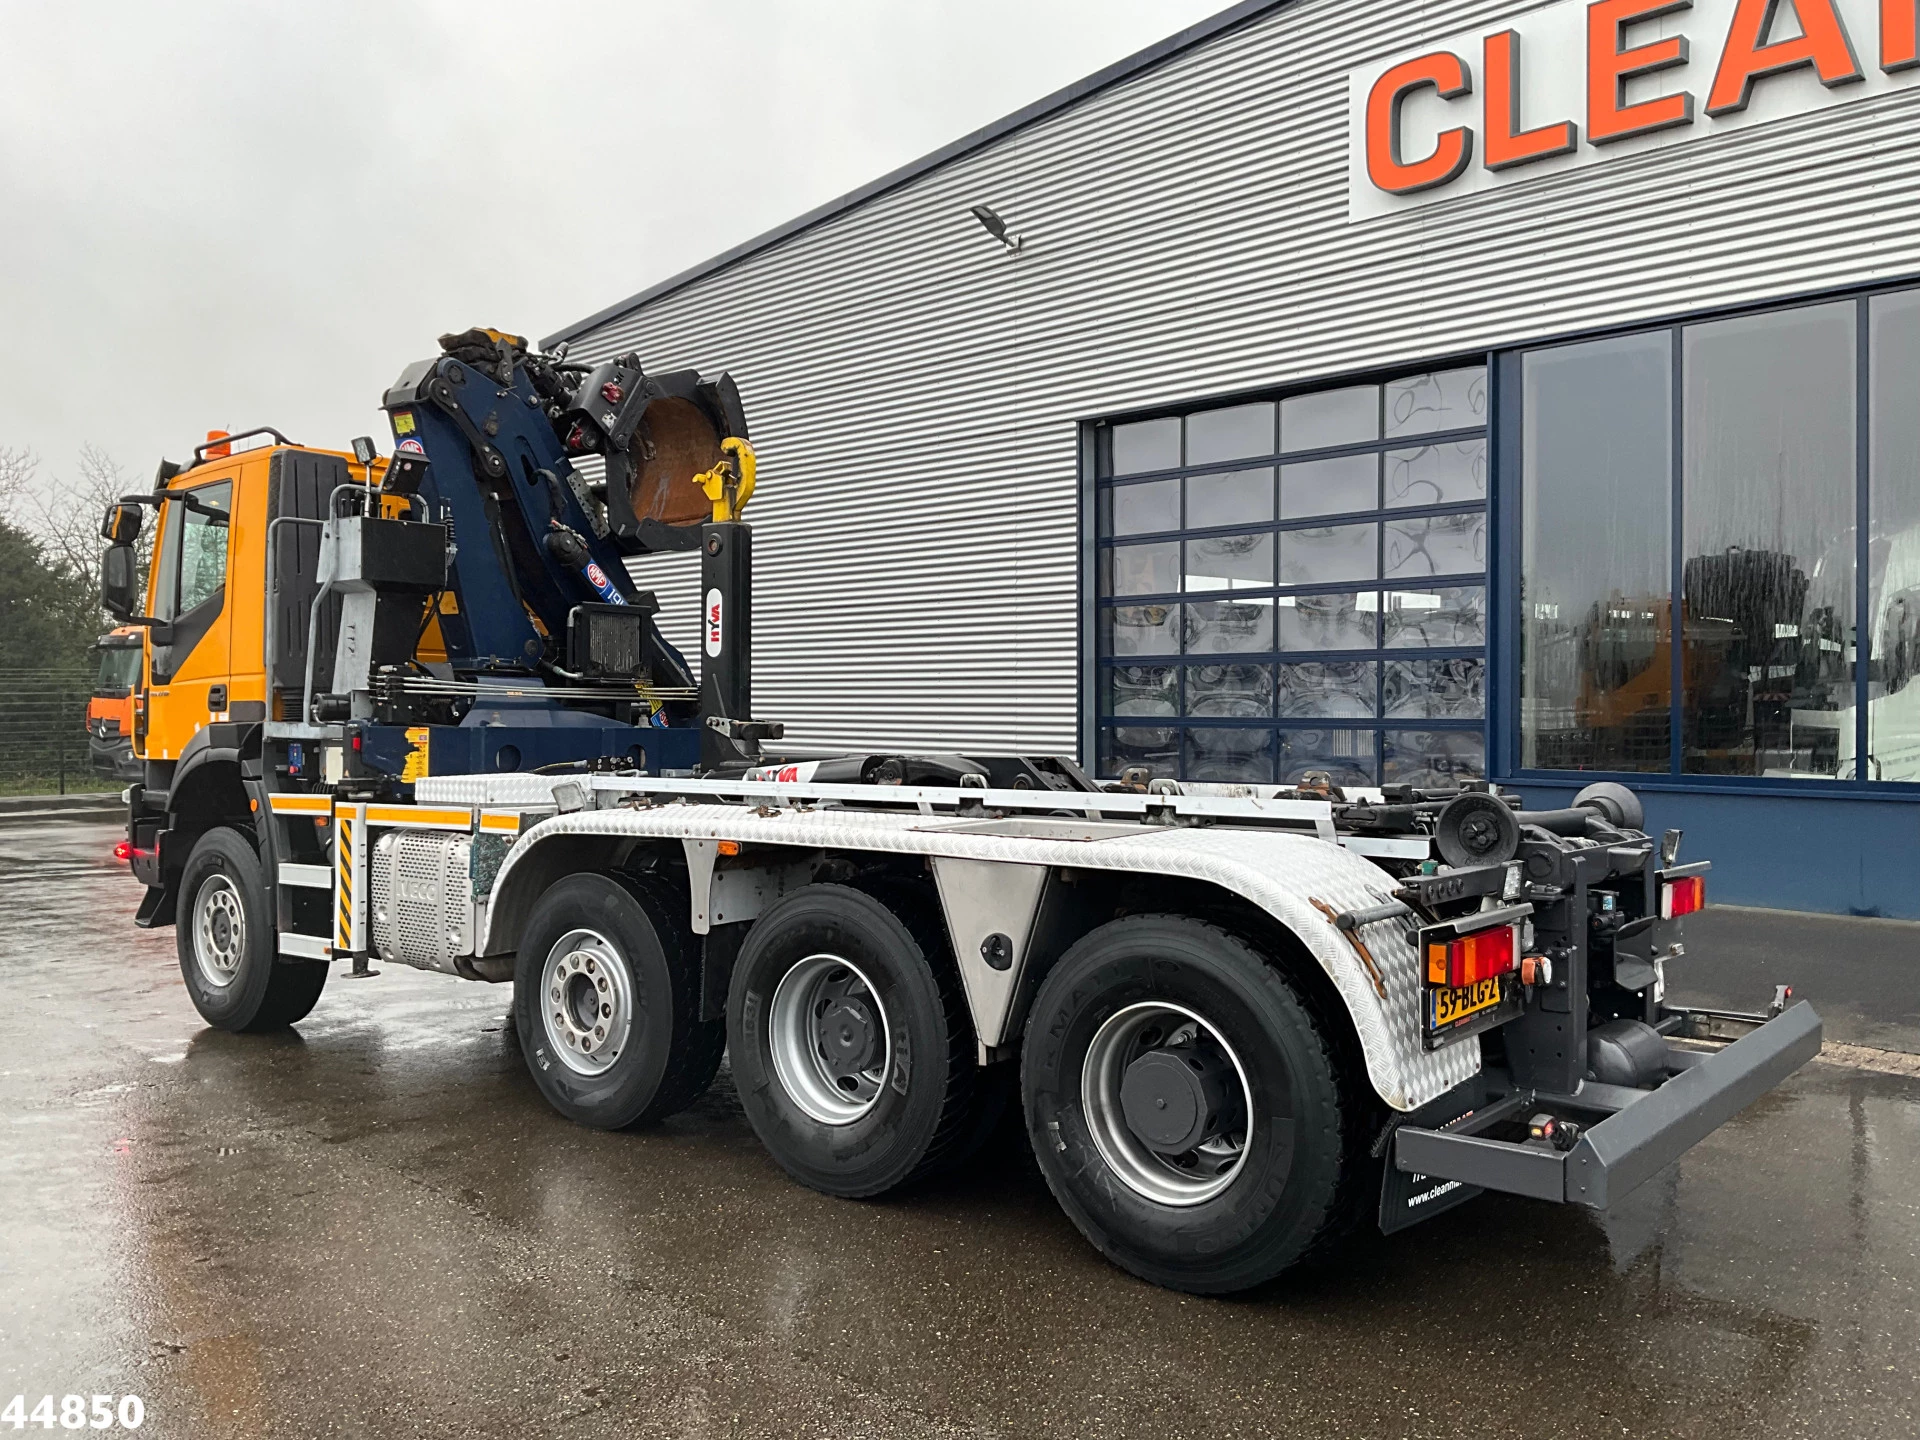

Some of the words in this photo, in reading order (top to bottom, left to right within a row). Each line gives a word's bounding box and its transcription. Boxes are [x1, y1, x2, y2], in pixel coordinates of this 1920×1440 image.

[588, 565, 606, 586] HMF
[707, 603, 720, 642] HYVA
[757, 764, 799, 782] YVA
[396, 879, 437, 901] IVECO
